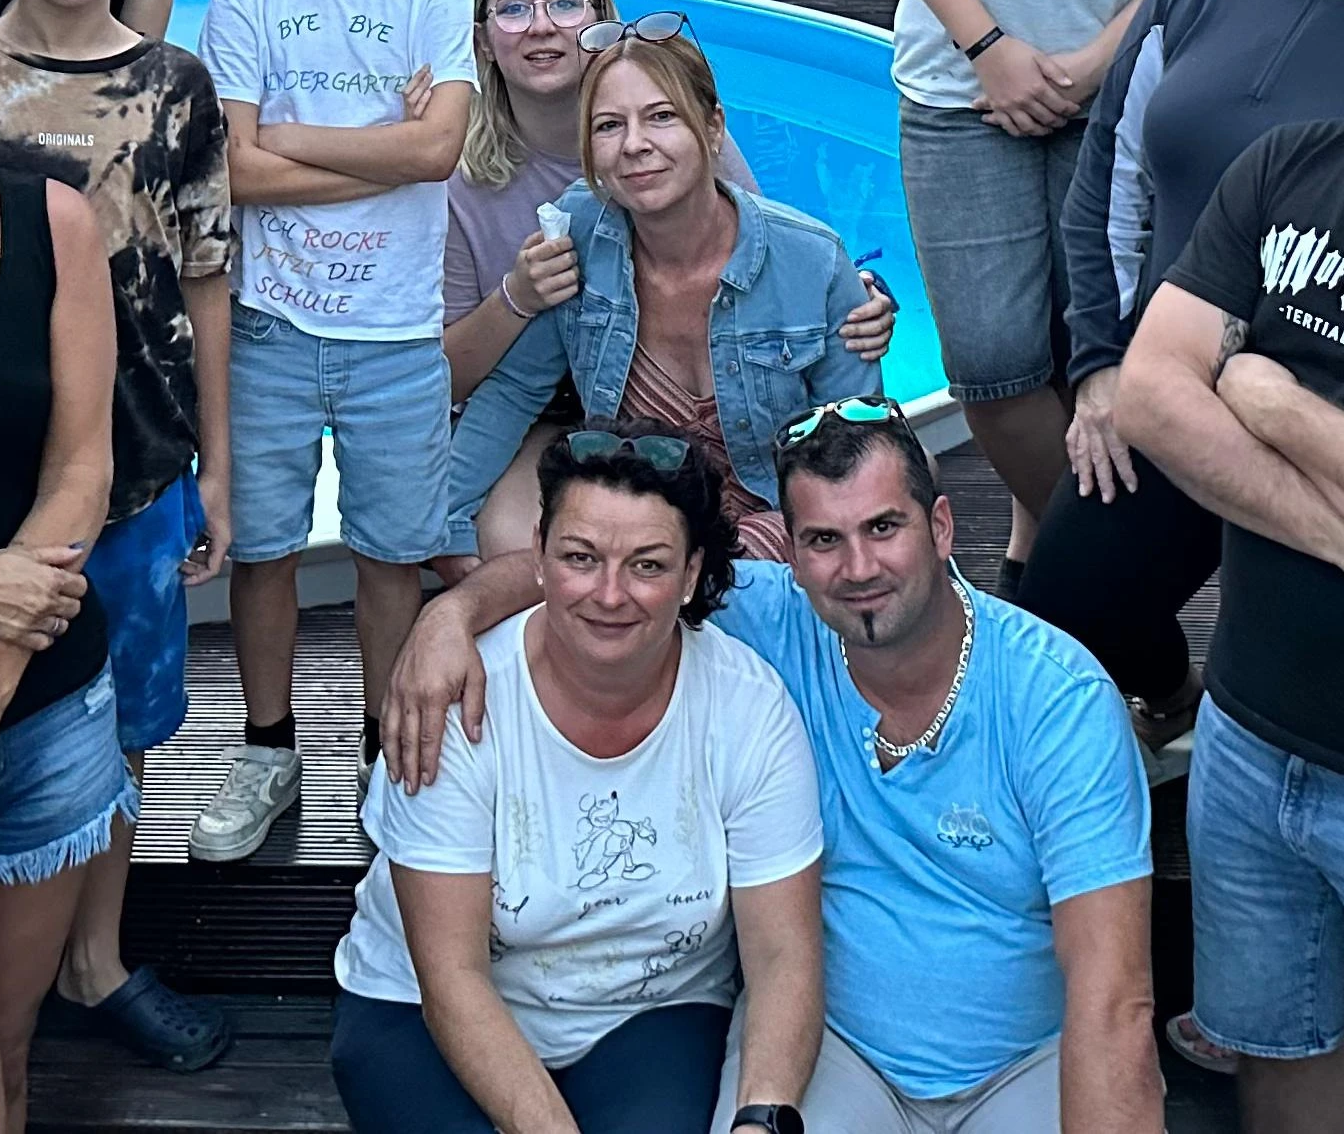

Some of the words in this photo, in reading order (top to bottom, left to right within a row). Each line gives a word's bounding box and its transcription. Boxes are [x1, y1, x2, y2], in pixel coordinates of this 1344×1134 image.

[277, 13, 321, 40] BYE
[348, 14, 394, 44] BYE
[38, 132, 95, 147] ORIGINALS
[302, 227, 393, 253] ROCKE
[251, 242, 323, 279] JETZT
[327, 262, 377, 283] DIE
[255, 276, 353, 314] SCHULE
[577, 895, 629, 920] your
